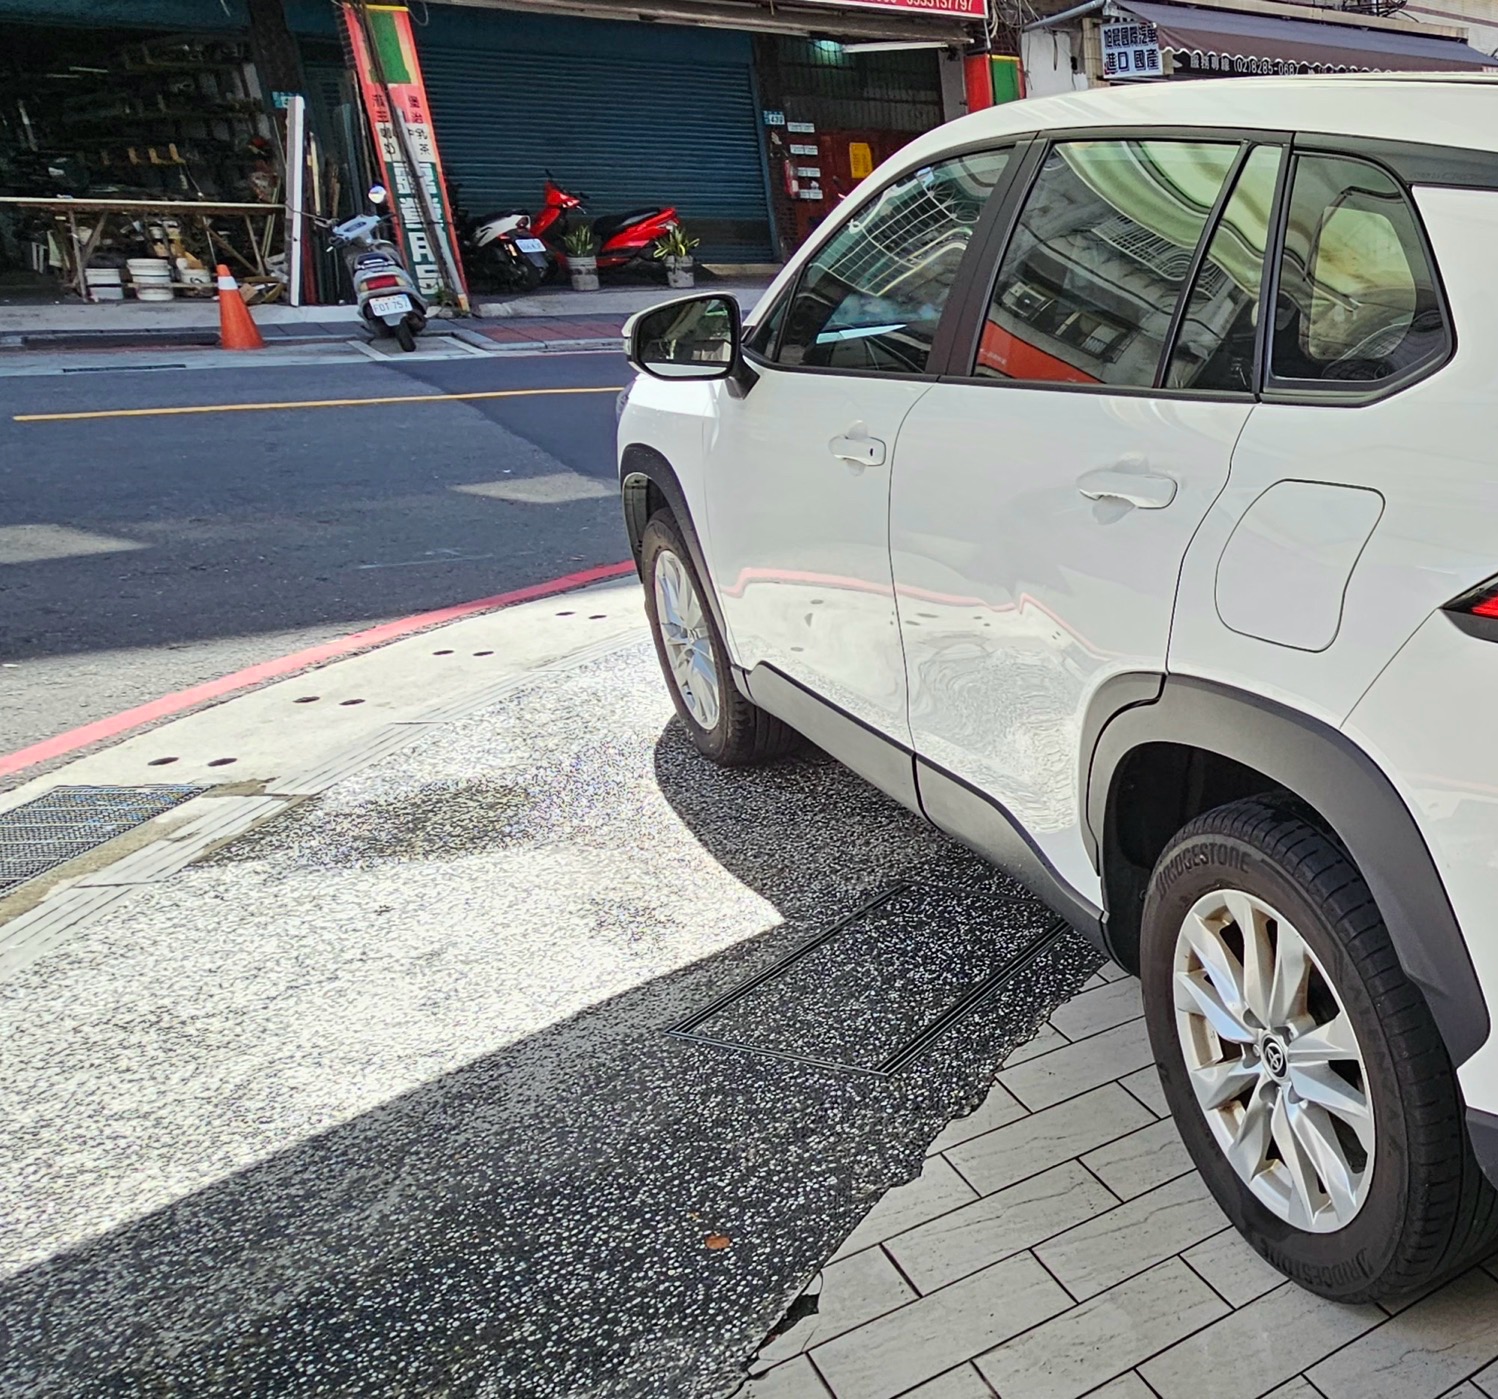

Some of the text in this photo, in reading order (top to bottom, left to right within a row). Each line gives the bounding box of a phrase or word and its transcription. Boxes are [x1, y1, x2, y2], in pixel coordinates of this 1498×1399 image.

[1105, 49, 1159, 72] 進口 國產
[1190, 53, 1230, 71] 服務專線
[1156, 842, 1252, 898] BRIDGESTONE
